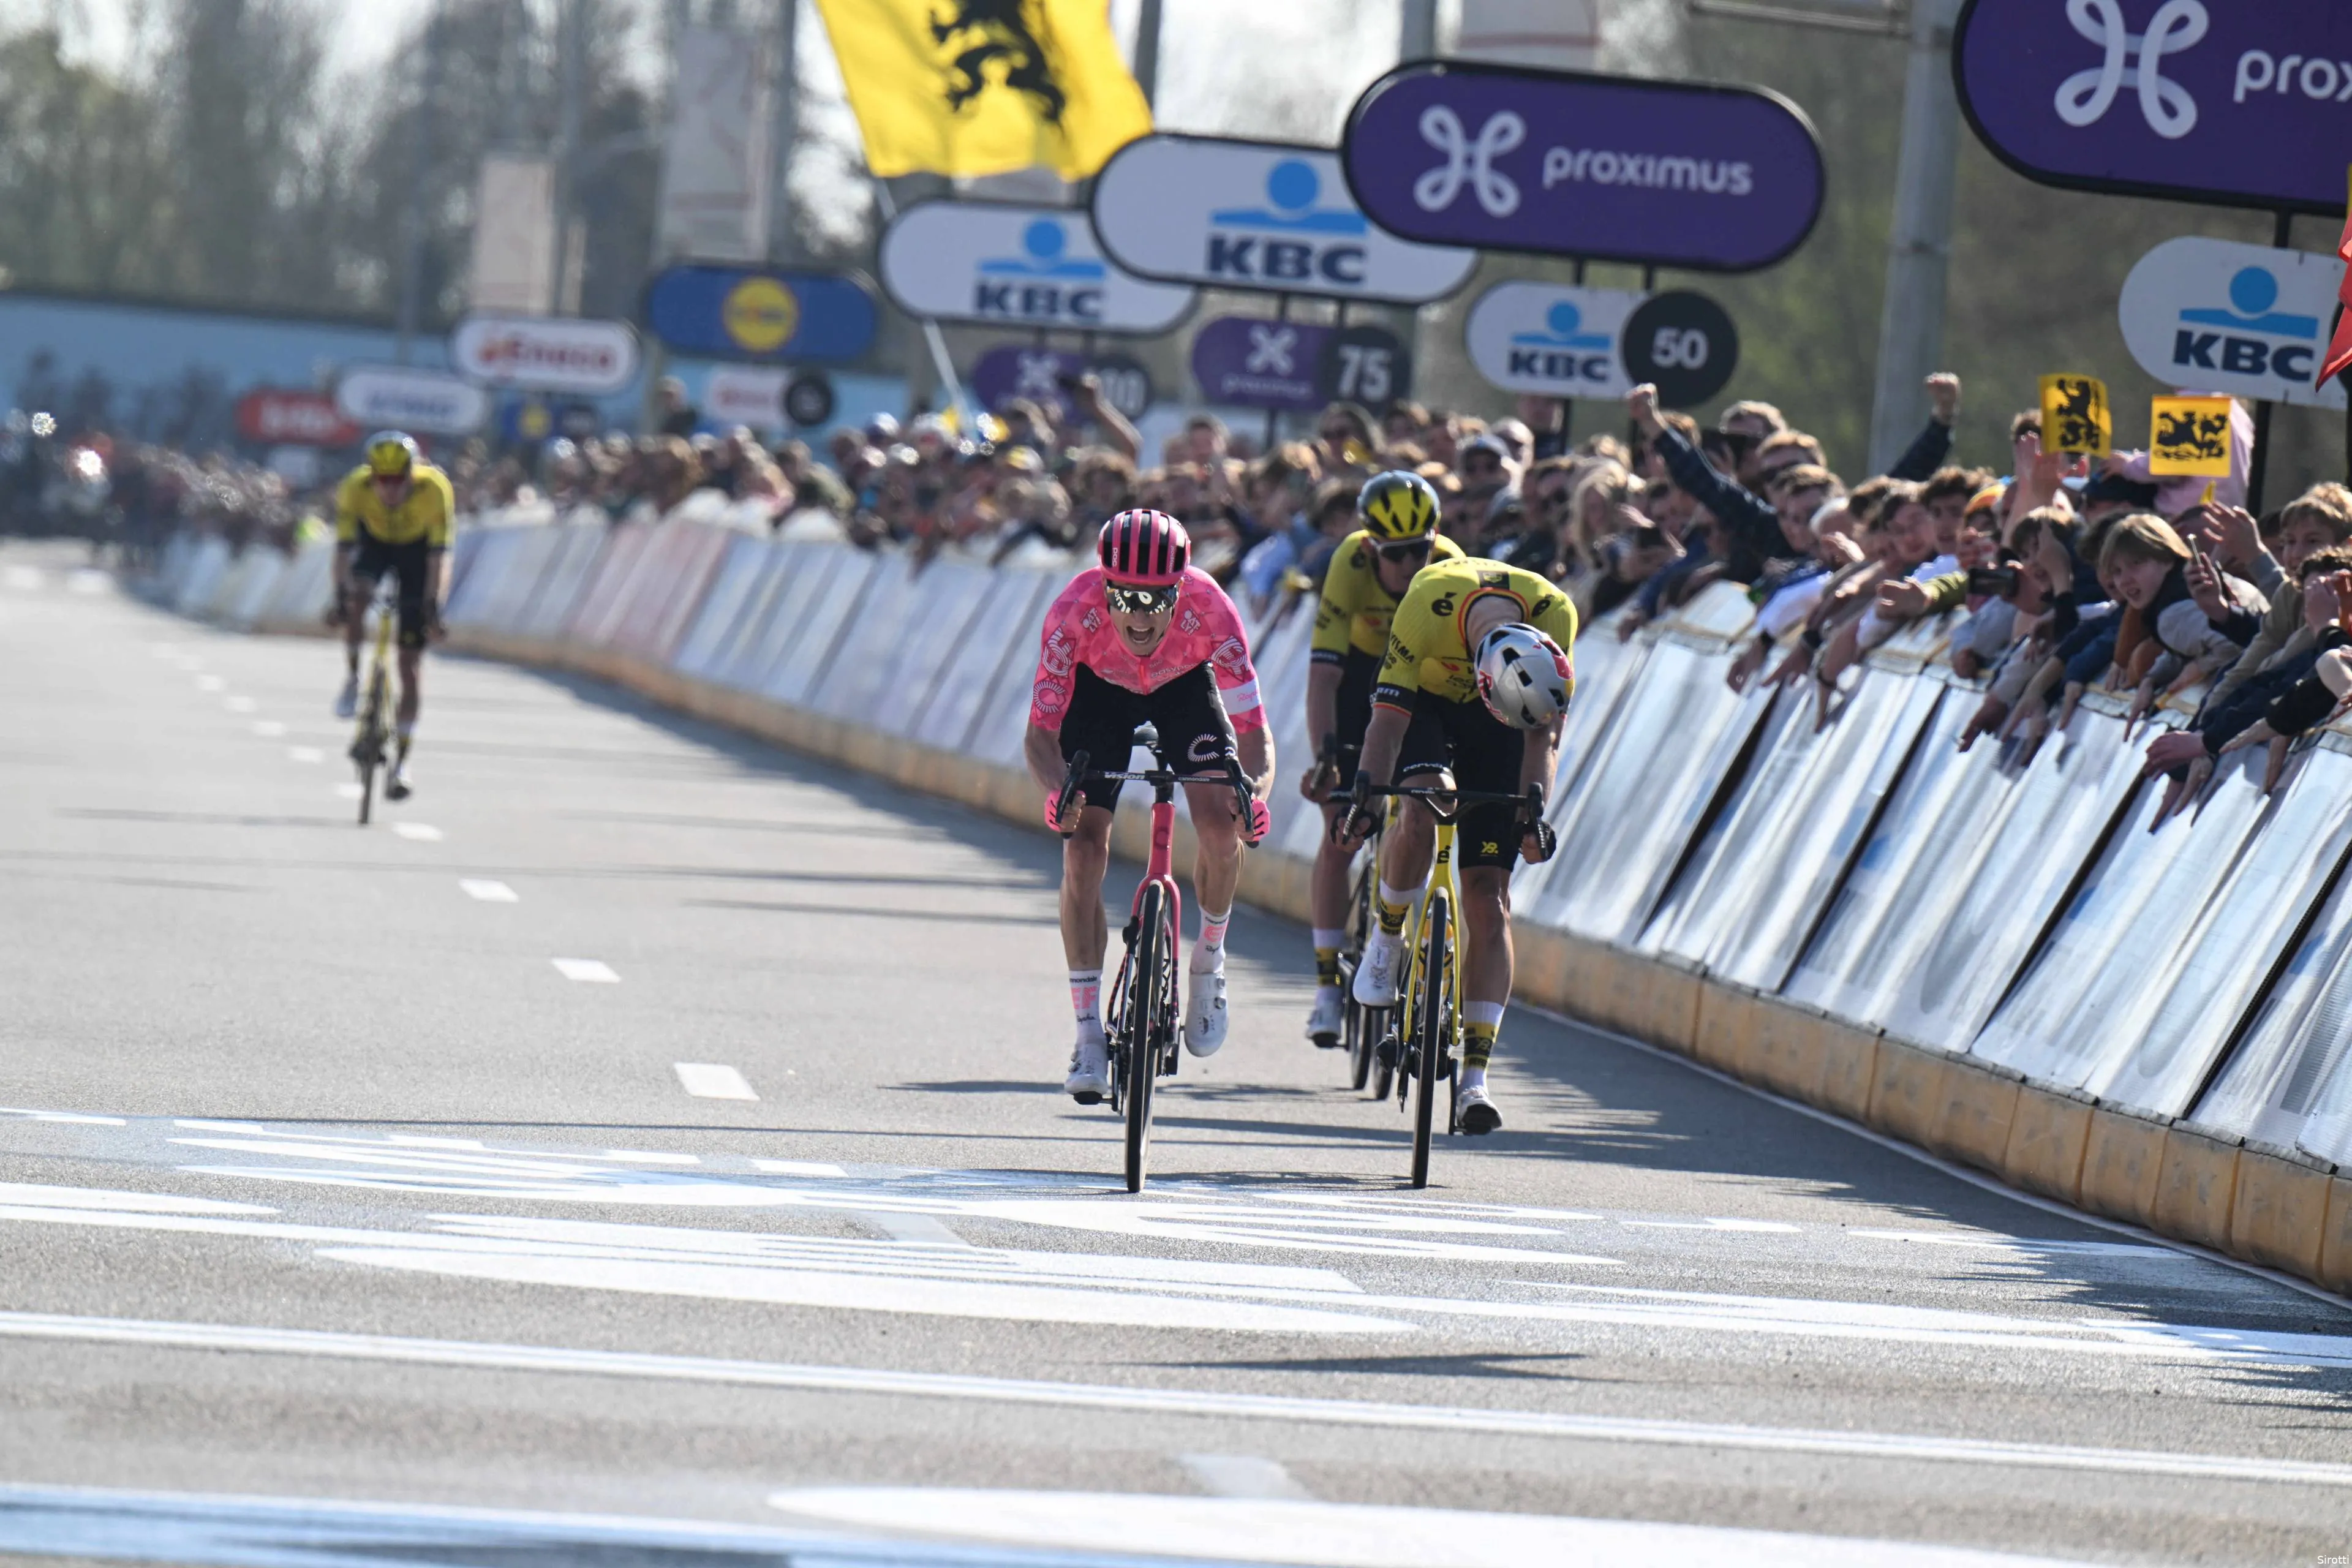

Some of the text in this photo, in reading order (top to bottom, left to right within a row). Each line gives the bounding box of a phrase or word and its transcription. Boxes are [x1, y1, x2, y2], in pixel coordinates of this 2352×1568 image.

[1542, 145, 1753, 196] proximus
[1207, 235, 1368, 284] KBC
[975, 282, 1104, 318] KBC
[1509, 349, 1611, 383] KBC
[1652, 326, 1708, 369] 50
[2173, 329, 2315, 383] KBC
[1338, 343, 1392, 402] 75
[1104, 771, 1145, 780] Vision
